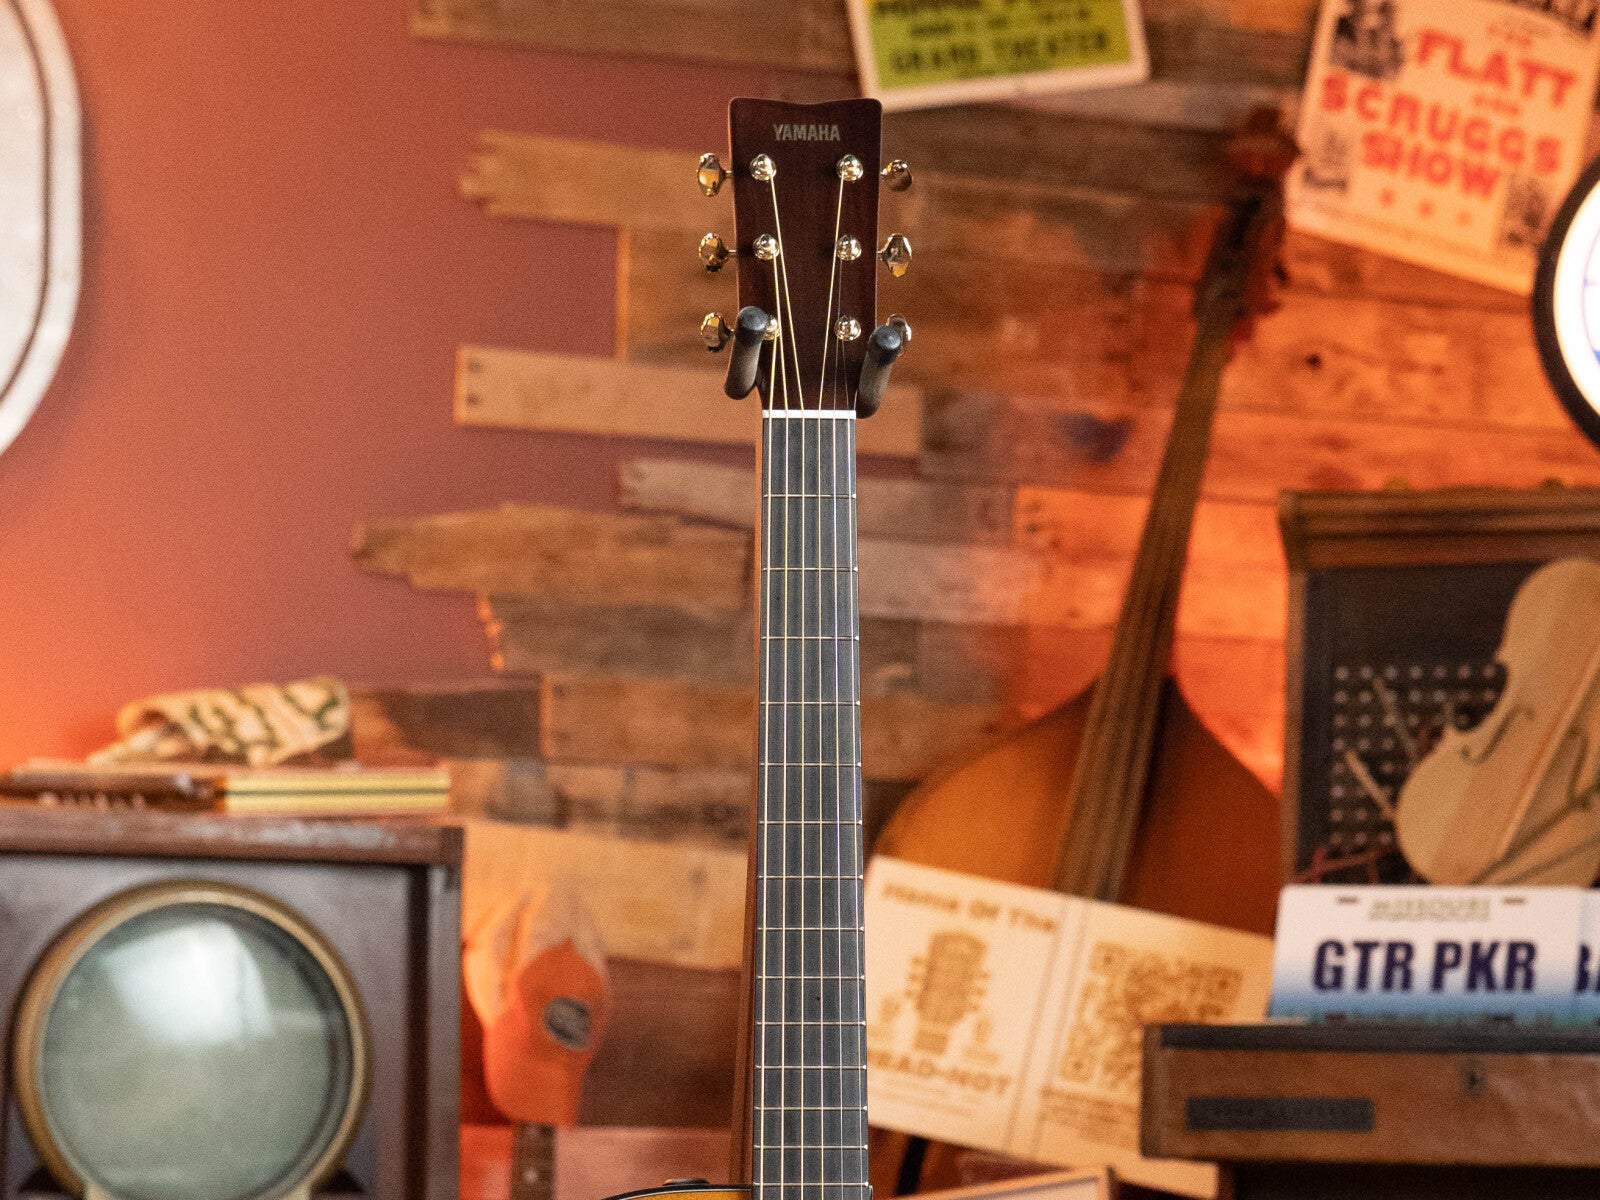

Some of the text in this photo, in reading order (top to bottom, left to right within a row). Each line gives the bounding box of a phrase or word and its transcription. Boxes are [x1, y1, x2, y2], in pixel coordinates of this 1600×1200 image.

[1416, 28, 1580, 108] FLATT
[773, 124, 841, 141] YAMAHA
[1321, 70, 1561, 177] SCRUGGS
[1361, 130, 1501, 201] SHOW
[1311, 938, 1538, 993] GTR PKR
